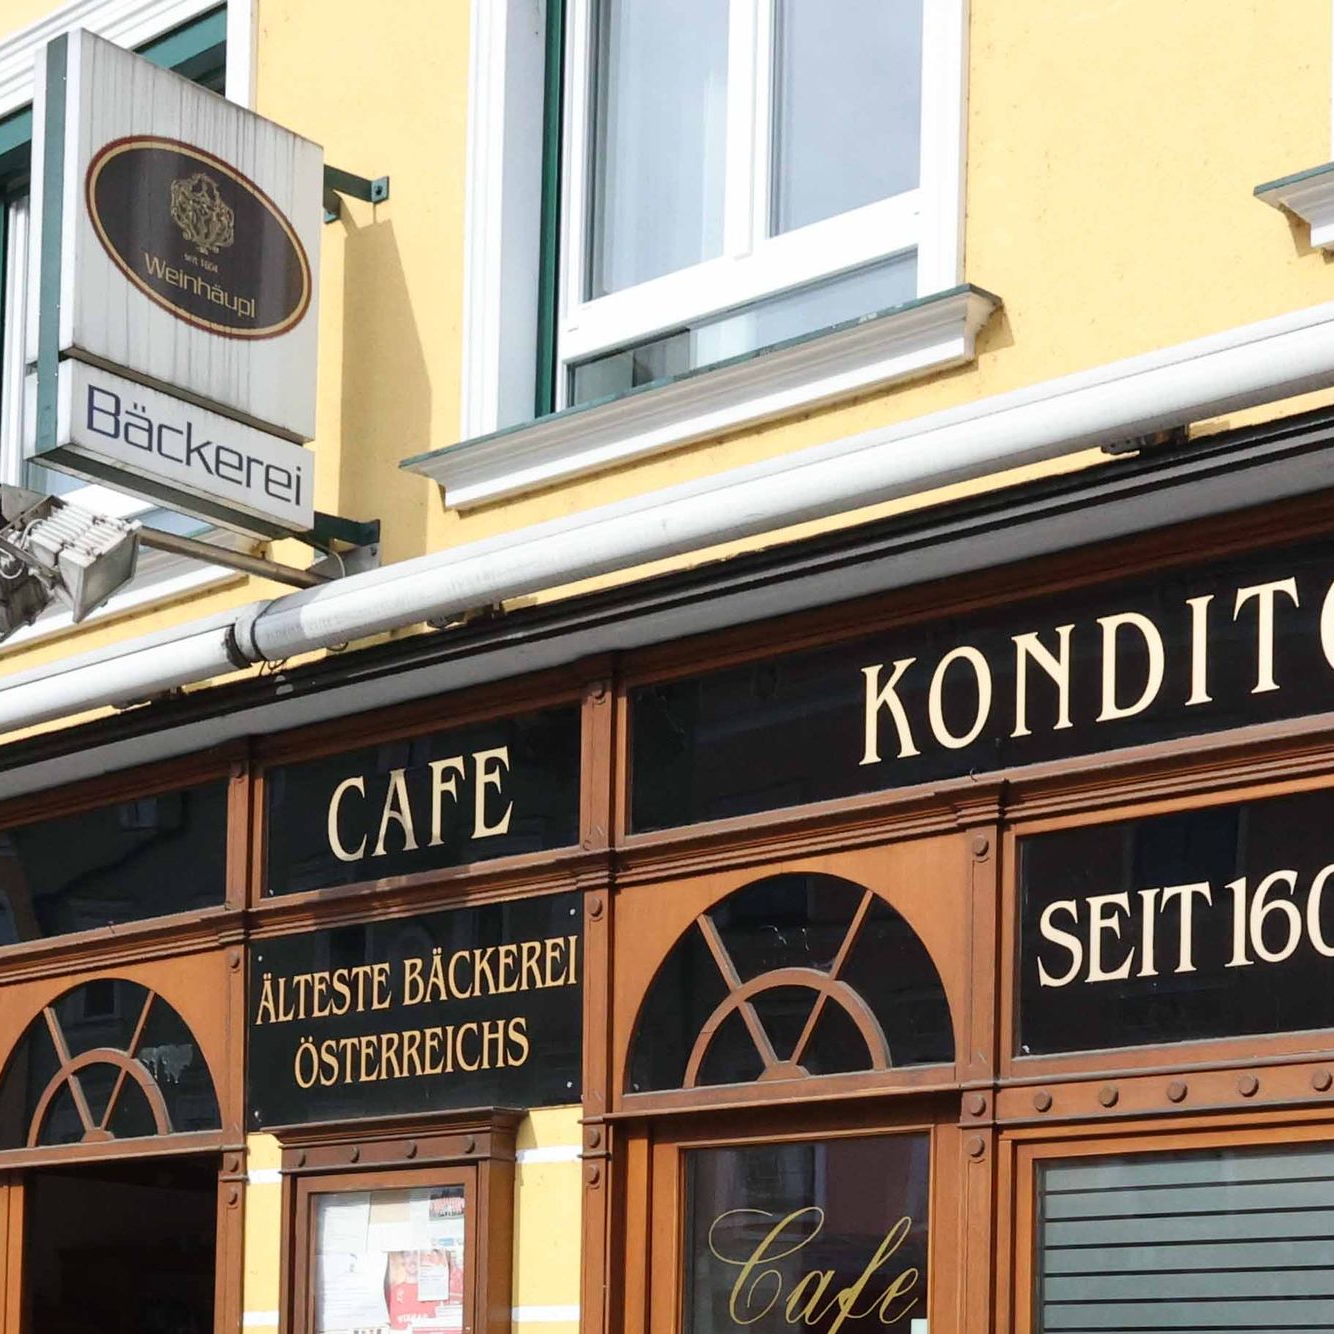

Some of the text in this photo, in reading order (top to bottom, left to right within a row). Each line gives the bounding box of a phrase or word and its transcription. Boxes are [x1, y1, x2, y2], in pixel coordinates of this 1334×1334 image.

[144, 252, 256, 318] Weinhäupl
[87, 384, 302, 506] Bäckerei
[327, 745, 515, 862] CAFE
[254, 935, 579, 1026] ÄLTESTE BÄCKEREI
[1036, 882, 1212, 988] SEIT
[294, 1016, 530, 1089] ÖSTERREICHS
